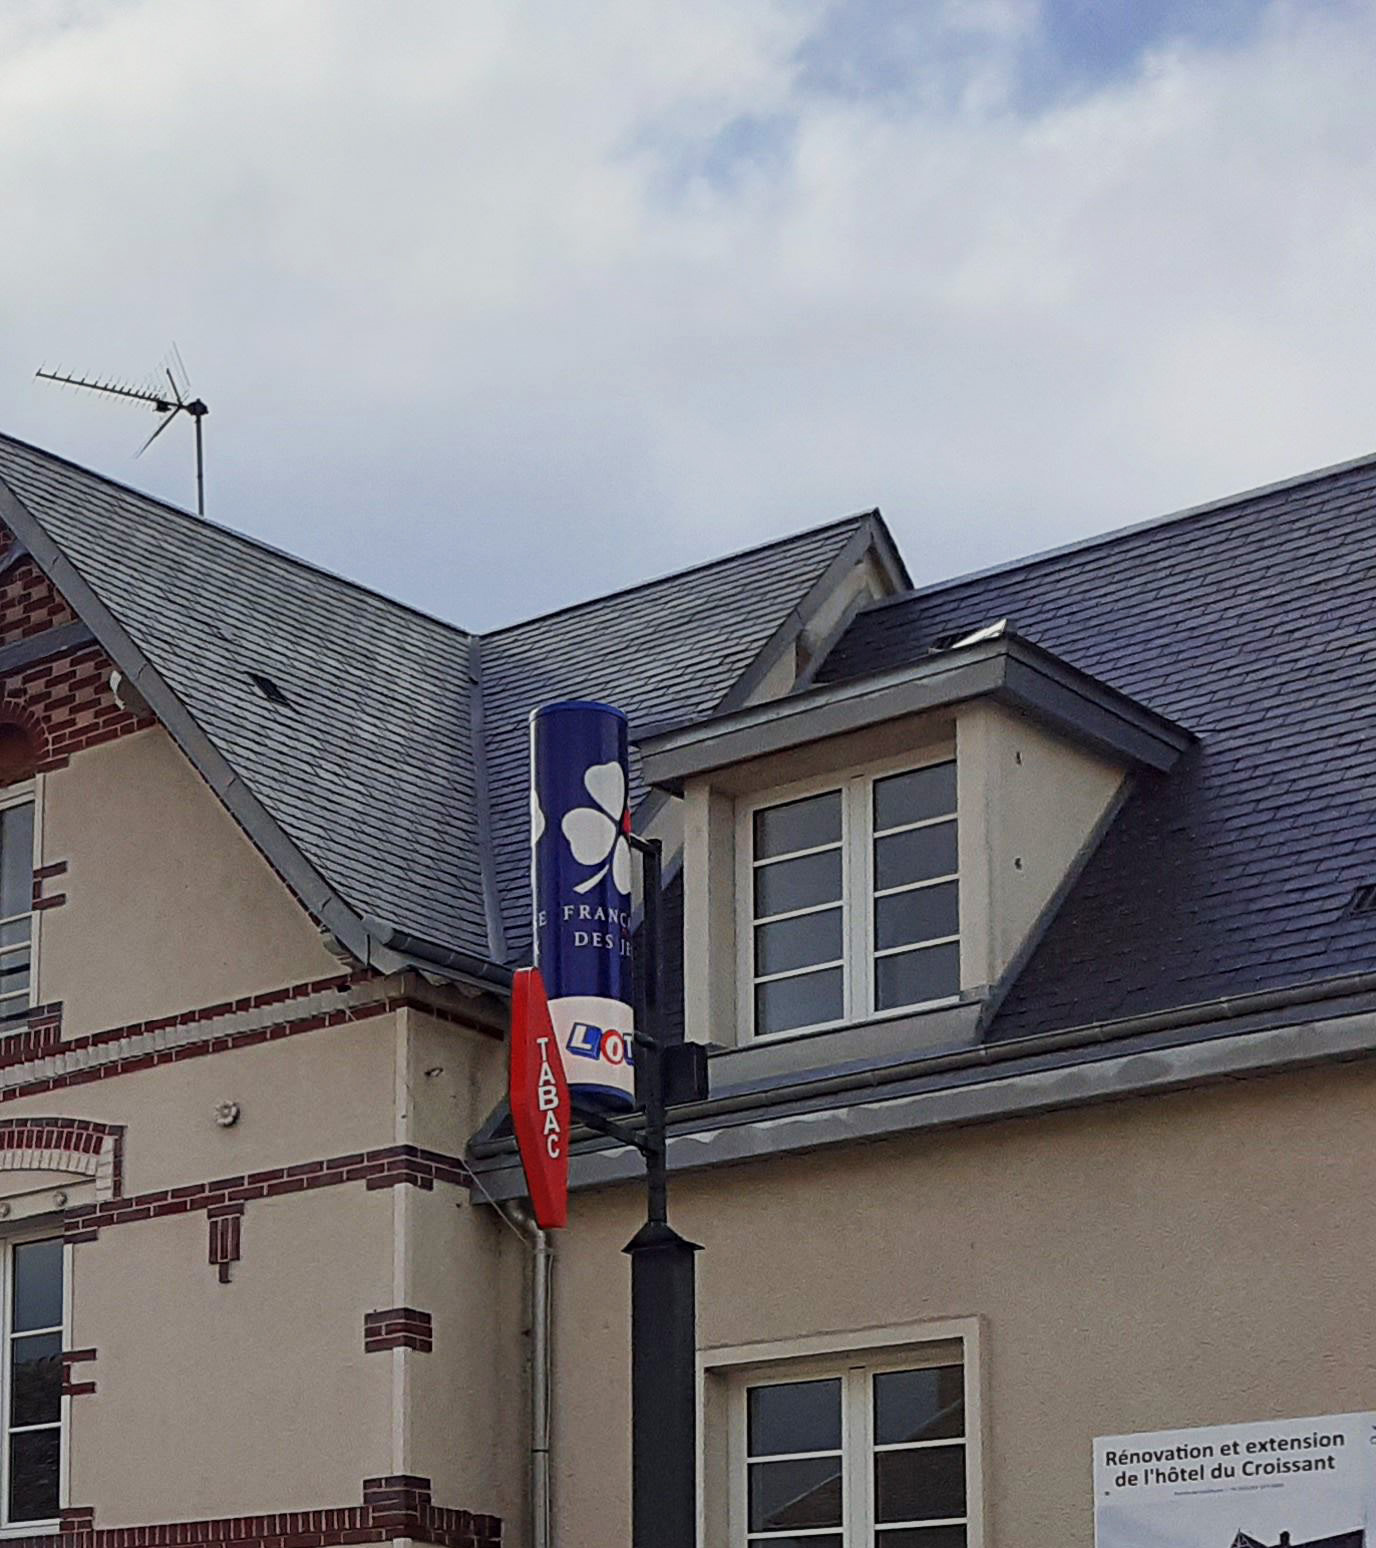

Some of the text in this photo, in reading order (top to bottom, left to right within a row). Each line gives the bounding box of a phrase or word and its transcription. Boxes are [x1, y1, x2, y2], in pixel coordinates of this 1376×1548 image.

[563, 904, 631, 928] FRANC
[574, 931, 613, 949] DES
[566, 1022, 634, 1066] LOT
[536, 1037, 561, 1158] TABAC
[1105, 1443, 1214, 1467] Rénovation
[1220, 1442, 1240, 1457] et
[1245, 1431, 1345, 1454] extension
[1115, 1454, 1336, 1487] de l'hôtel du Croissant
